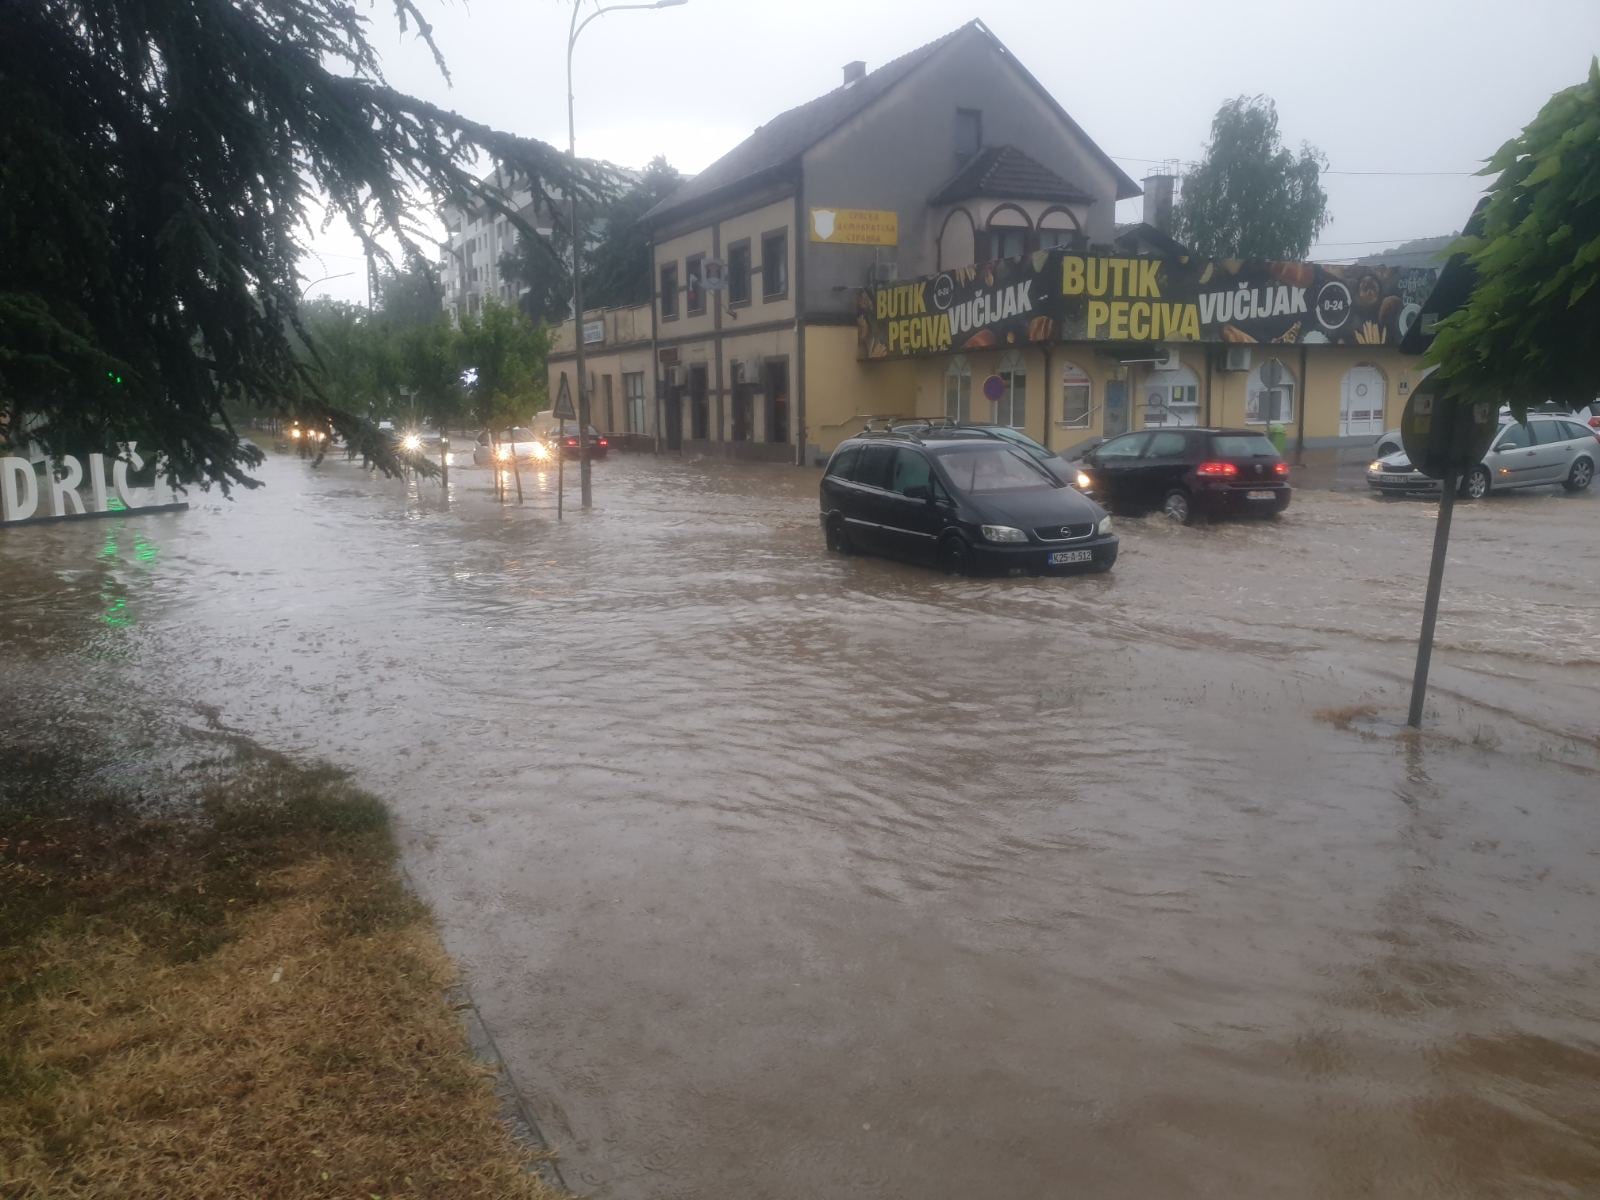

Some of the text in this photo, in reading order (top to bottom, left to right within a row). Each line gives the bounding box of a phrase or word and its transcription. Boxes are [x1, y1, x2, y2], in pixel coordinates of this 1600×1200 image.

[1062, 255, 1162, 298] BUTIK
[876, 281, 927, 320] BUTIK
[949, 279, 1033, 336] VUČIJAK
[1087, 299, 1201, 341] PECIVA
[1198, 281, 1308, 325] VUČIJAK
[1324, 299, 1344, 311] 0-24
[888, 313, 953, 352] PECIVA
